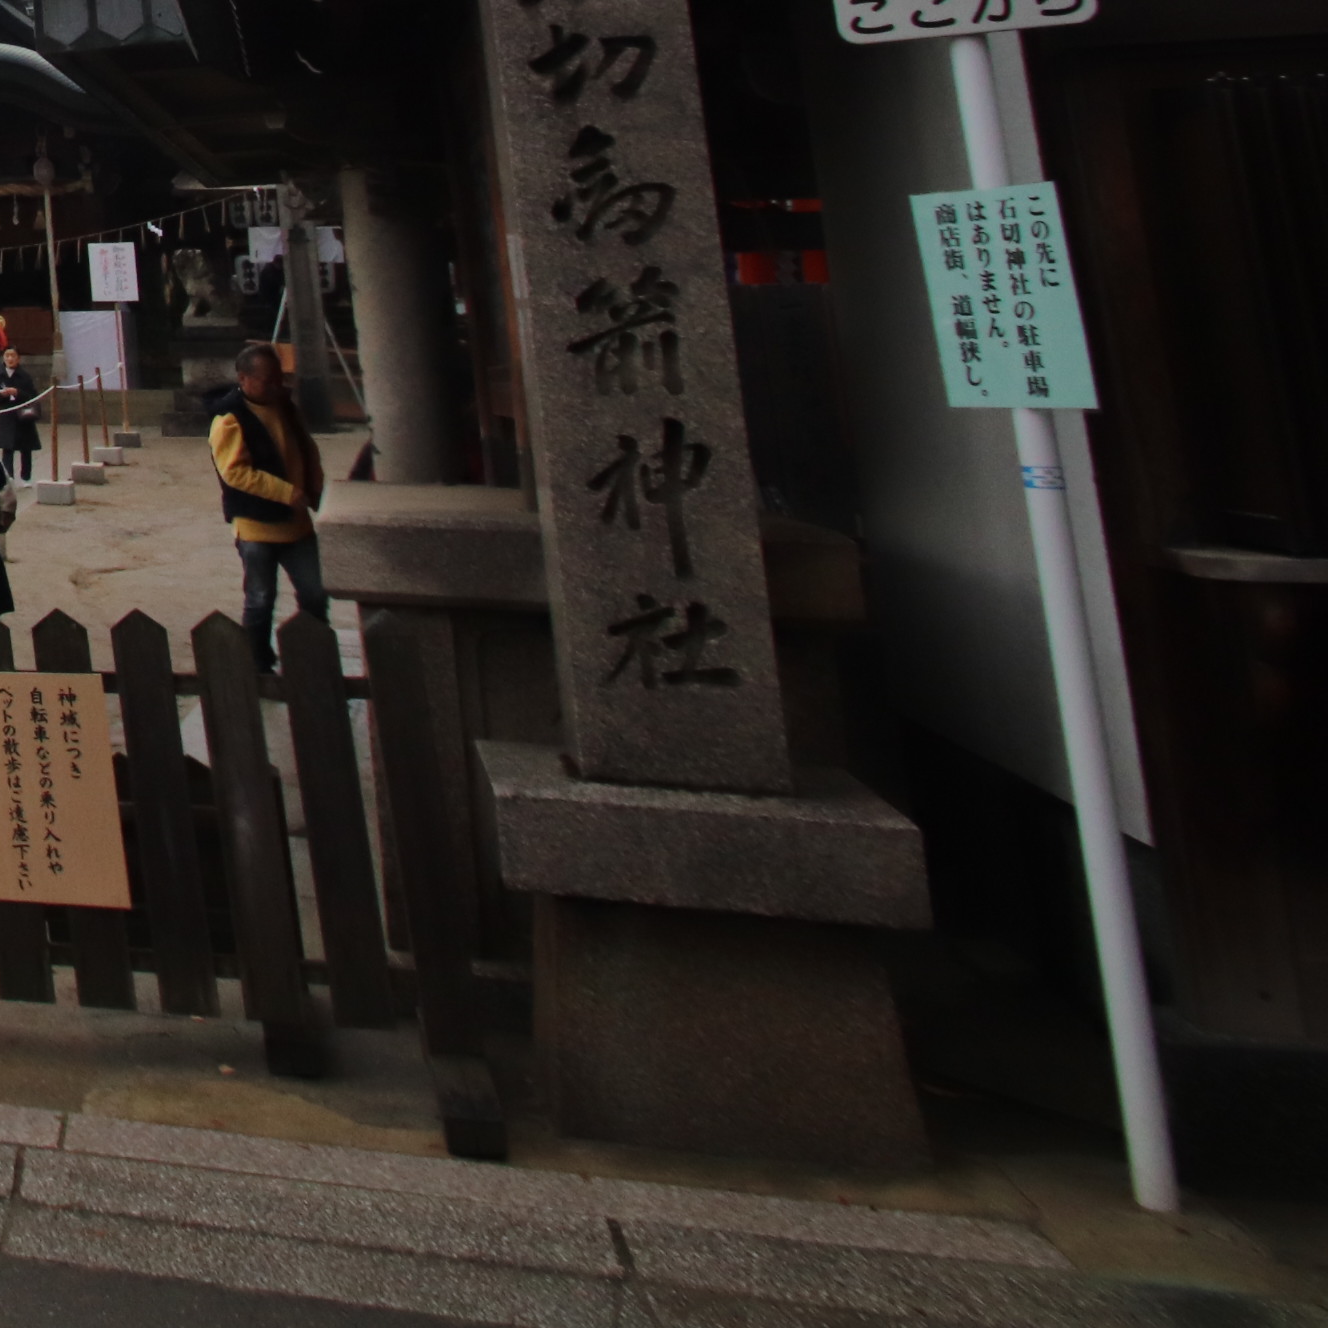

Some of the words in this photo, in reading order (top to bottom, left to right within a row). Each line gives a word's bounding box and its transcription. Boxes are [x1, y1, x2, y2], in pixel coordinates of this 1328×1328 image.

[966, 202, 1010, 349] はありません。
[999, 198, 1050, 398] 石切神社の駐車場
[1028, 195, 1061, 288] この先に
[29, 687, 64, 876] 自転車などの乗り入れや
[57, 687, 82, 780] 神域につき
